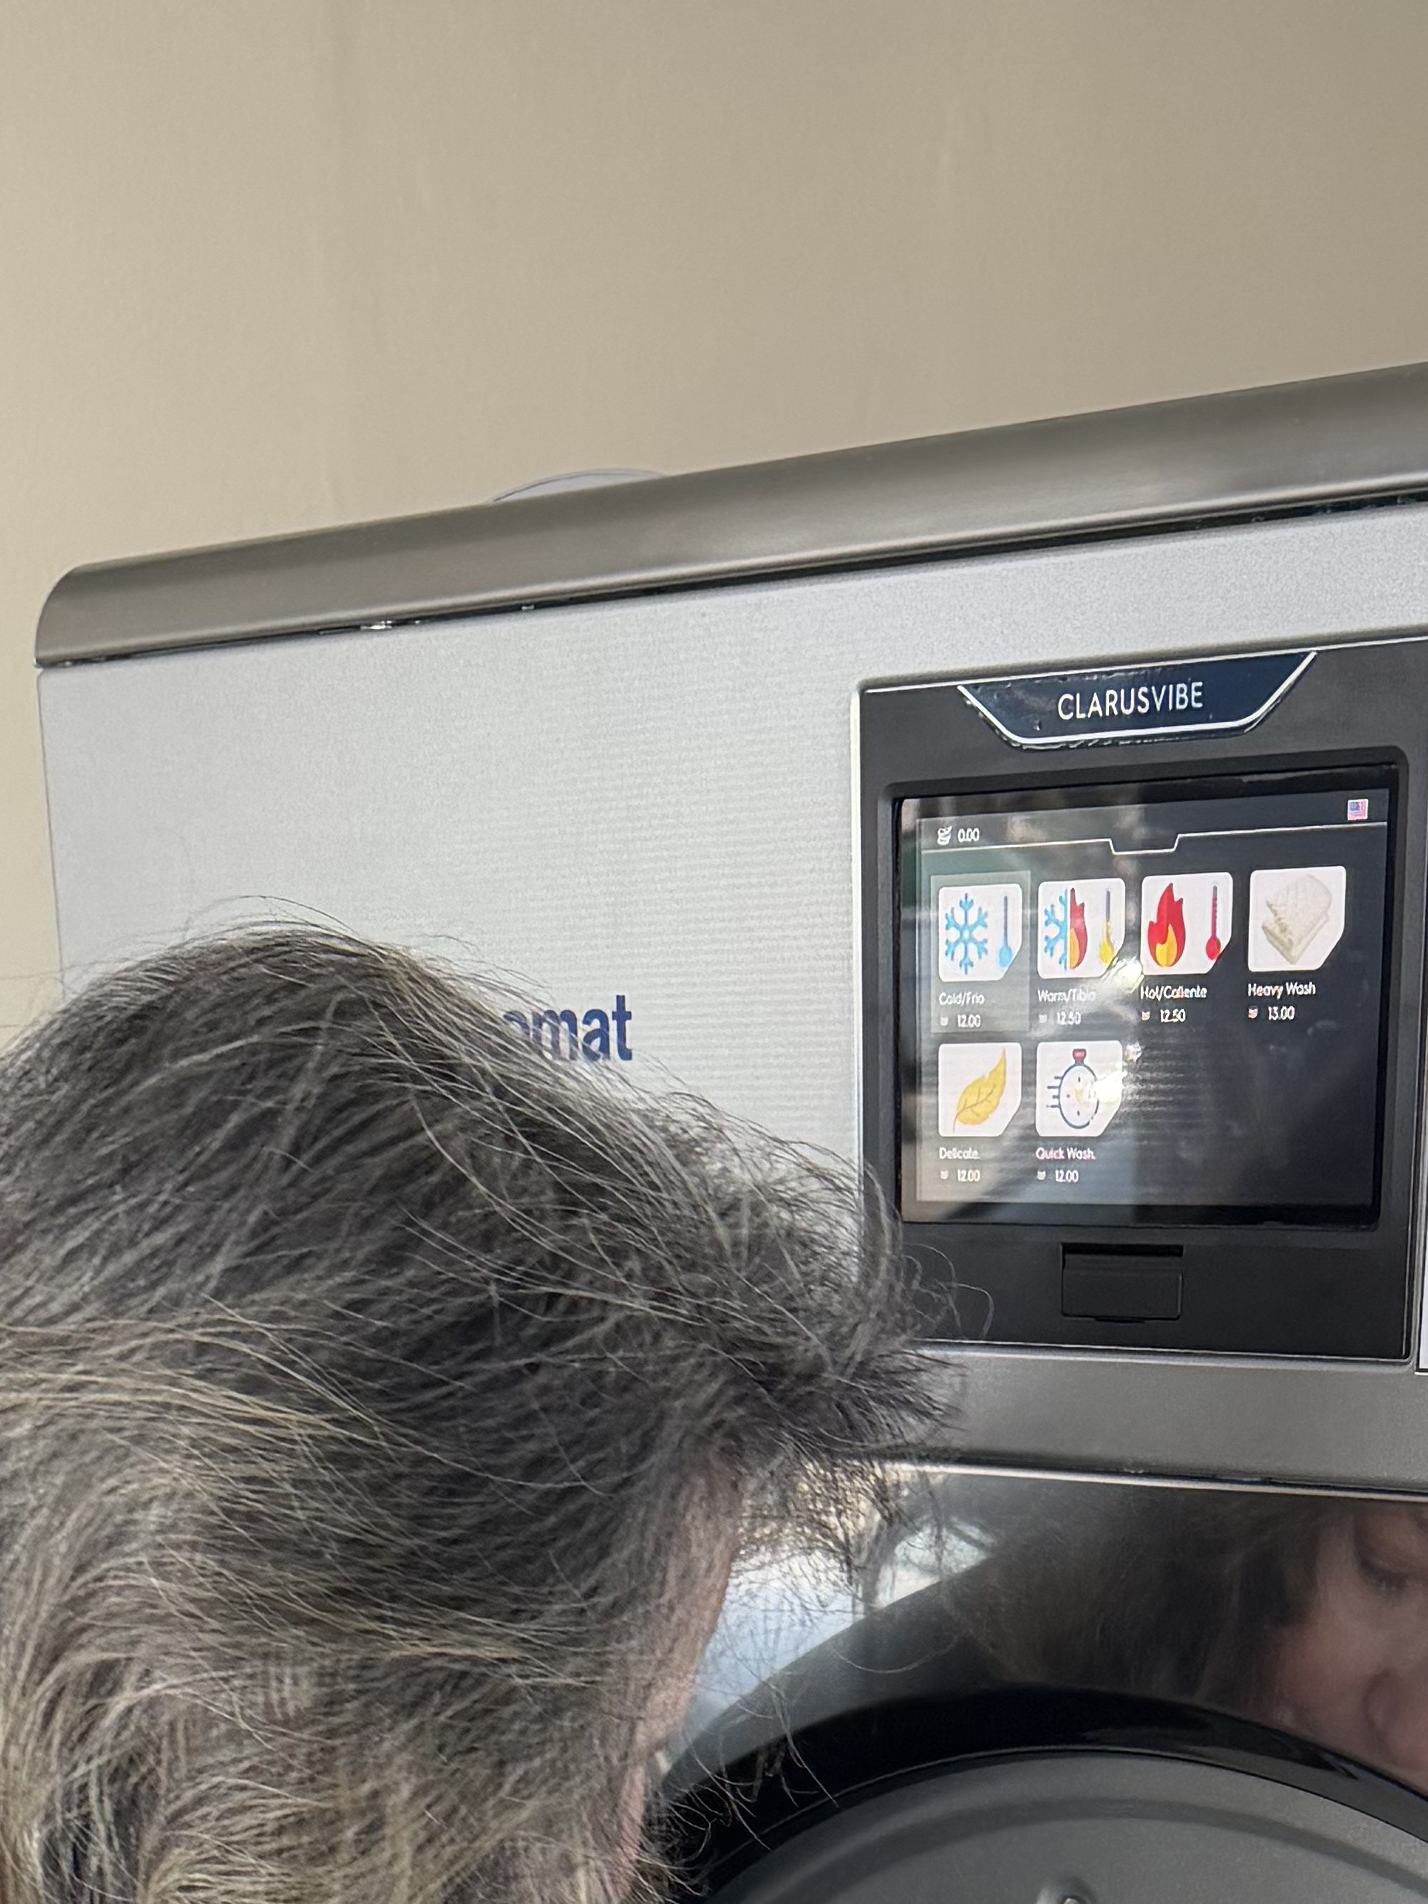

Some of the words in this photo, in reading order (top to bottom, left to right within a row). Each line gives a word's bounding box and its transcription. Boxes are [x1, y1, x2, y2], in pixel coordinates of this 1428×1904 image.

[1058, 681, 1204, 721] CLARUSVIBE
[1140, 984, 1208, 1001] Hot/Caliente
[1247, 982, 1283, 1000] Heavy
[1285, 981, 1316, 997] Wash
[957, 1014, 982, 1028] 12.00
[1160, 1008, 1186, 1023] 12.50
[1267, 1006, 1295, 1021] 13.00
[1035, 1146, 1065, 1161] Quick
[957, 1169, 981, 1183] 12.00
[1055, 1169, 1080, 1183] 12.00
